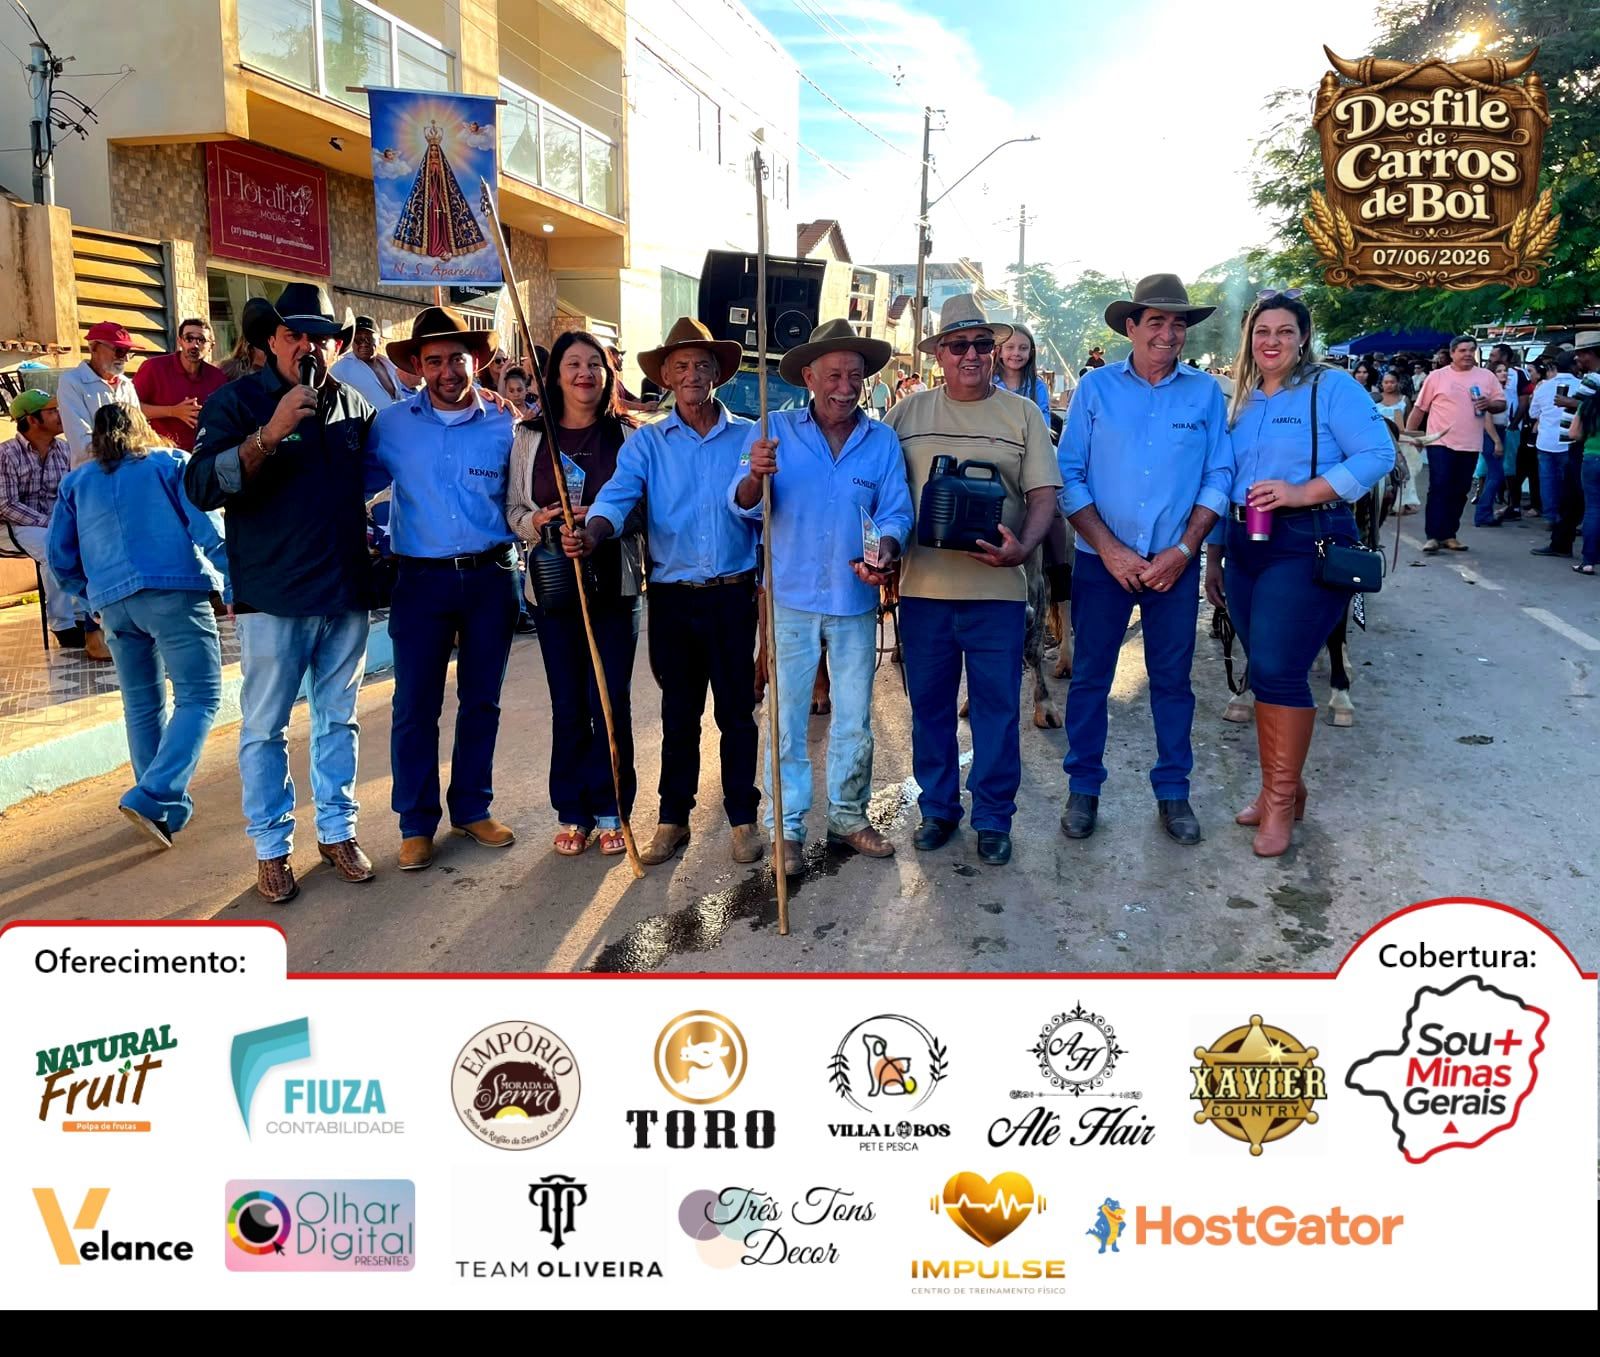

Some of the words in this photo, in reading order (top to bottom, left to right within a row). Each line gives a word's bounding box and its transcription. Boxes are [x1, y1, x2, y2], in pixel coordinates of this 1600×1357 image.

[393, 262, 408, 275] N.
[415, 262, 425, 276] S.
[1271, 416, 1302, 424] FABRÍCIA
[468, 467, 499, 479] RENATO
